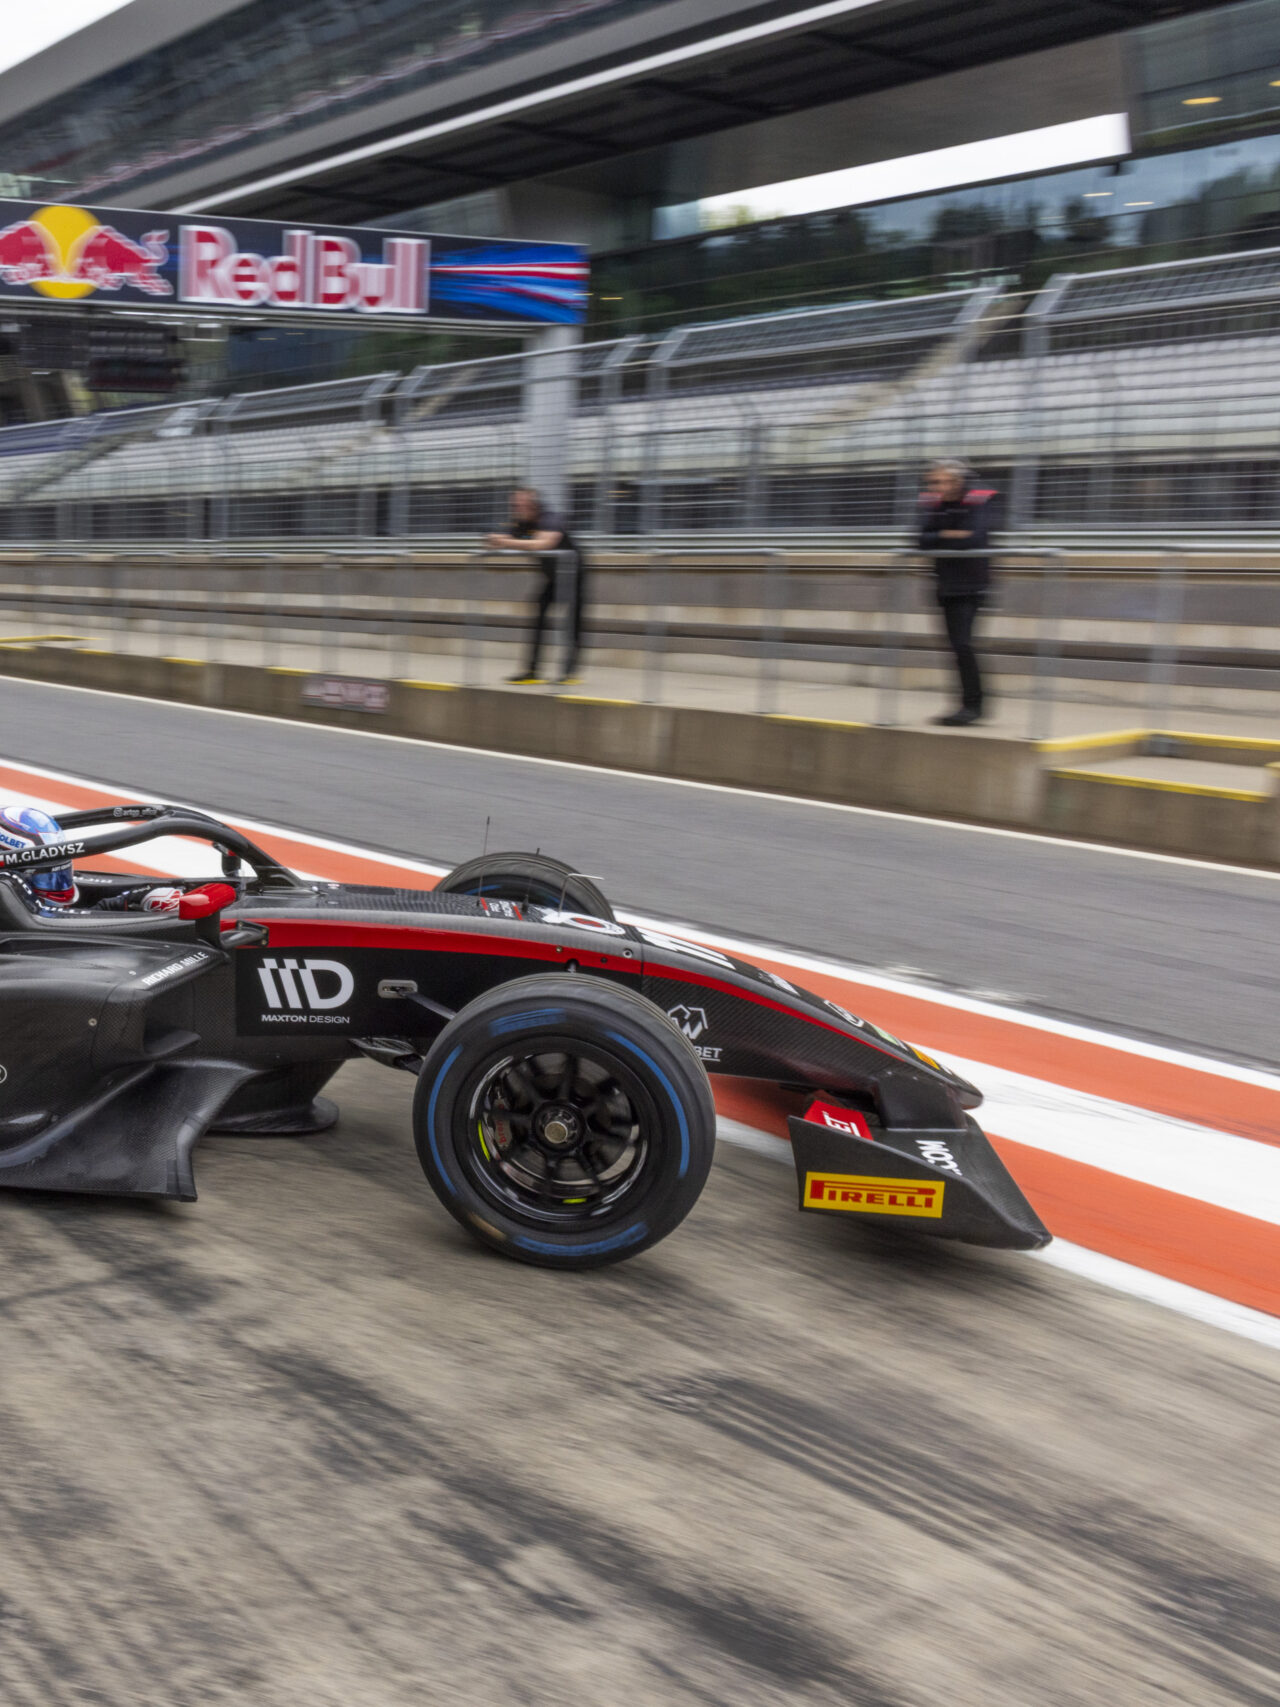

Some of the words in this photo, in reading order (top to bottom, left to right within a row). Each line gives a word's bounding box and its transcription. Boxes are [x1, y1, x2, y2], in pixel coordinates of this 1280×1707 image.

[5, 842, 85, 864] M.GLADYSZ
[141, 962, 183, 986] RICHARD
[181, 951, 209, 968] MILLE
[261, 1014, 307, 1023] MAXTON
[309, 1015, 350, 1024] DESIGN
[810, 1179, 937, 1208] PIRELLI
